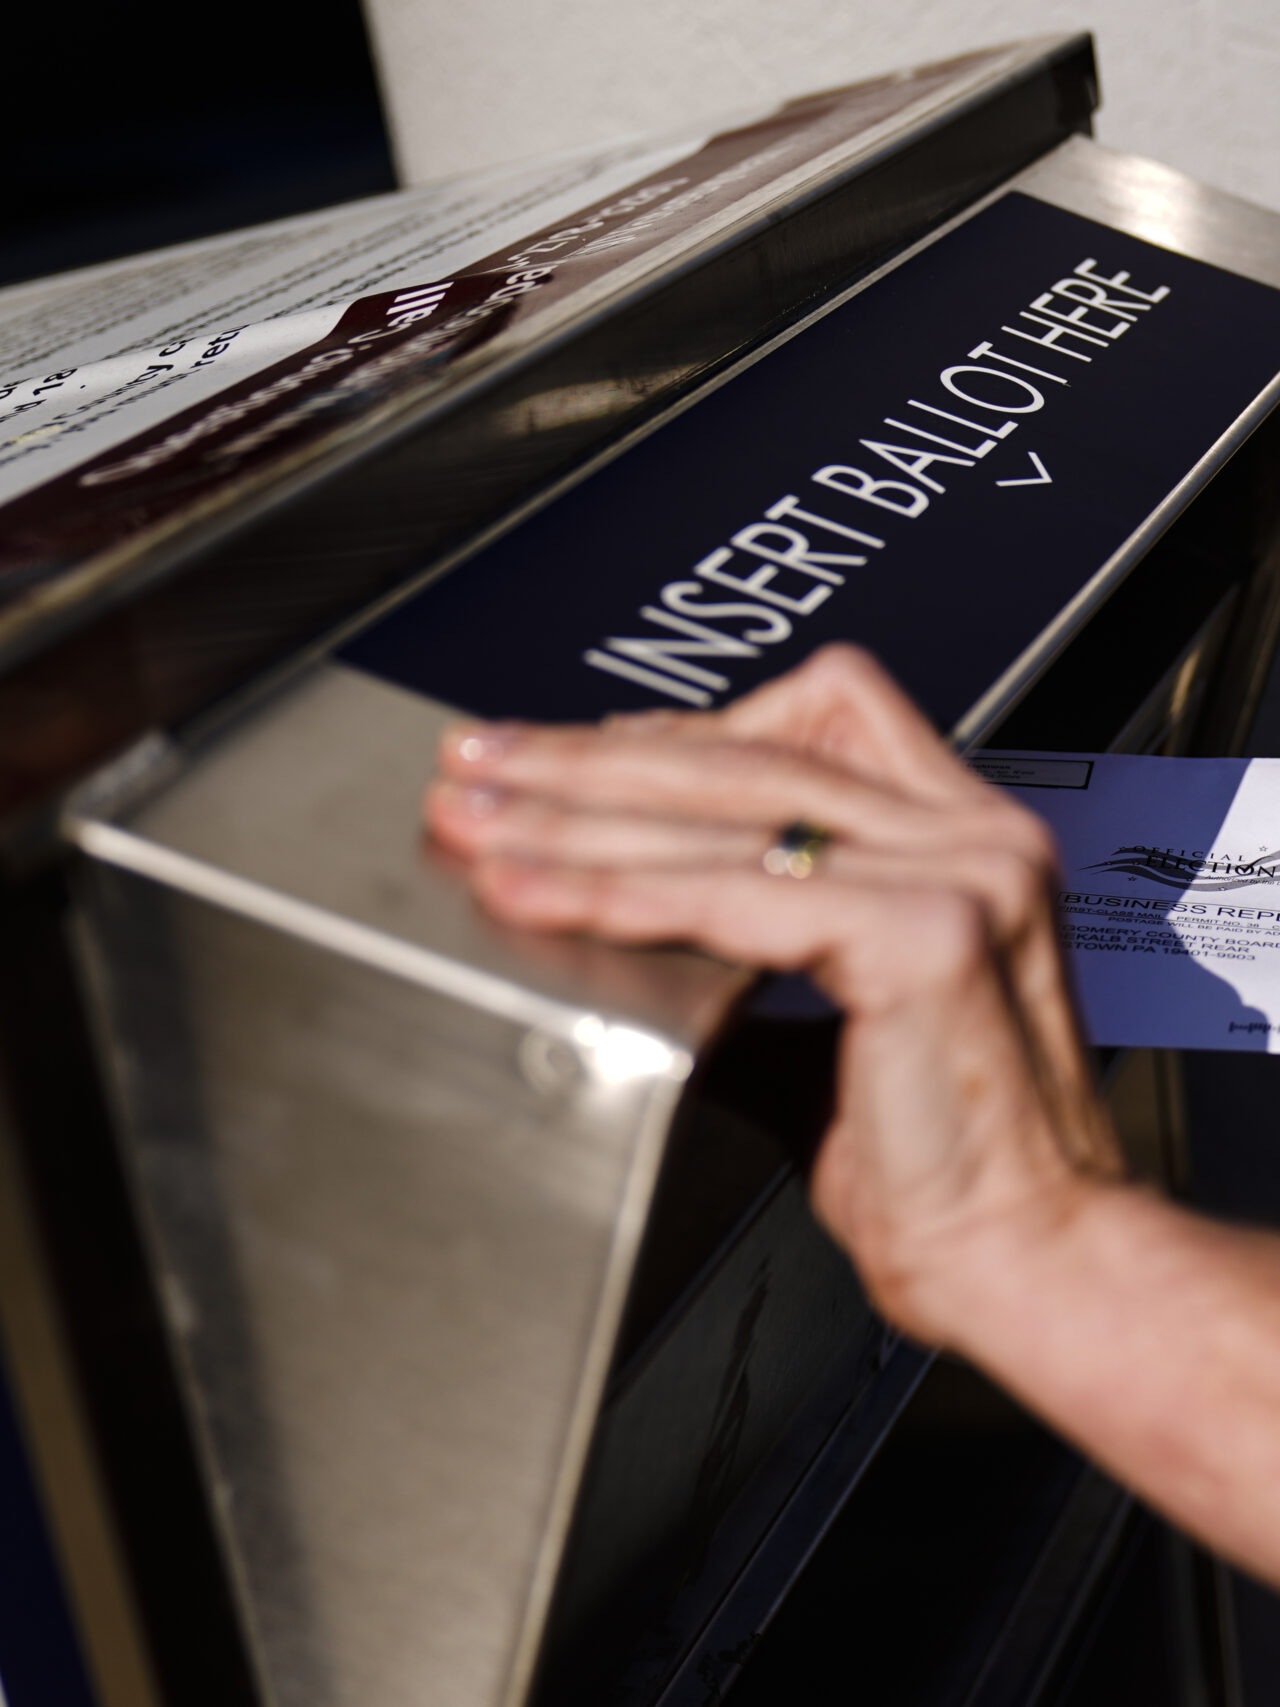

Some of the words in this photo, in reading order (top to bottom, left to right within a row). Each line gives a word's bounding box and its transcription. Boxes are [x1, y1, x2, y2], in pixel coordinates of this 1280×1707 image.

[583, 494, 886, 707] INSERT
[811, 340, 1070, 518] BALLOT
[1000, 257, 1171, 363] HERE
[1133, 845, 1245, 862] OFFICIAL
[1145, 855, 1276, 879] ELECTION
[1064, 894, 1207, 914] BUSINESS
[1107, 916, 1165, 926] POSTAGE
[1167, 921, 1194, 930] WILL
[1176, 915, 1220, 926] PERMIT
[1125, 936, 1195, 948] STREET
[1200, 943, 1250, 954] REAR
[1144, 930, 1220, 943] COUNTY
[1131, 944, 1157, 953] PA
